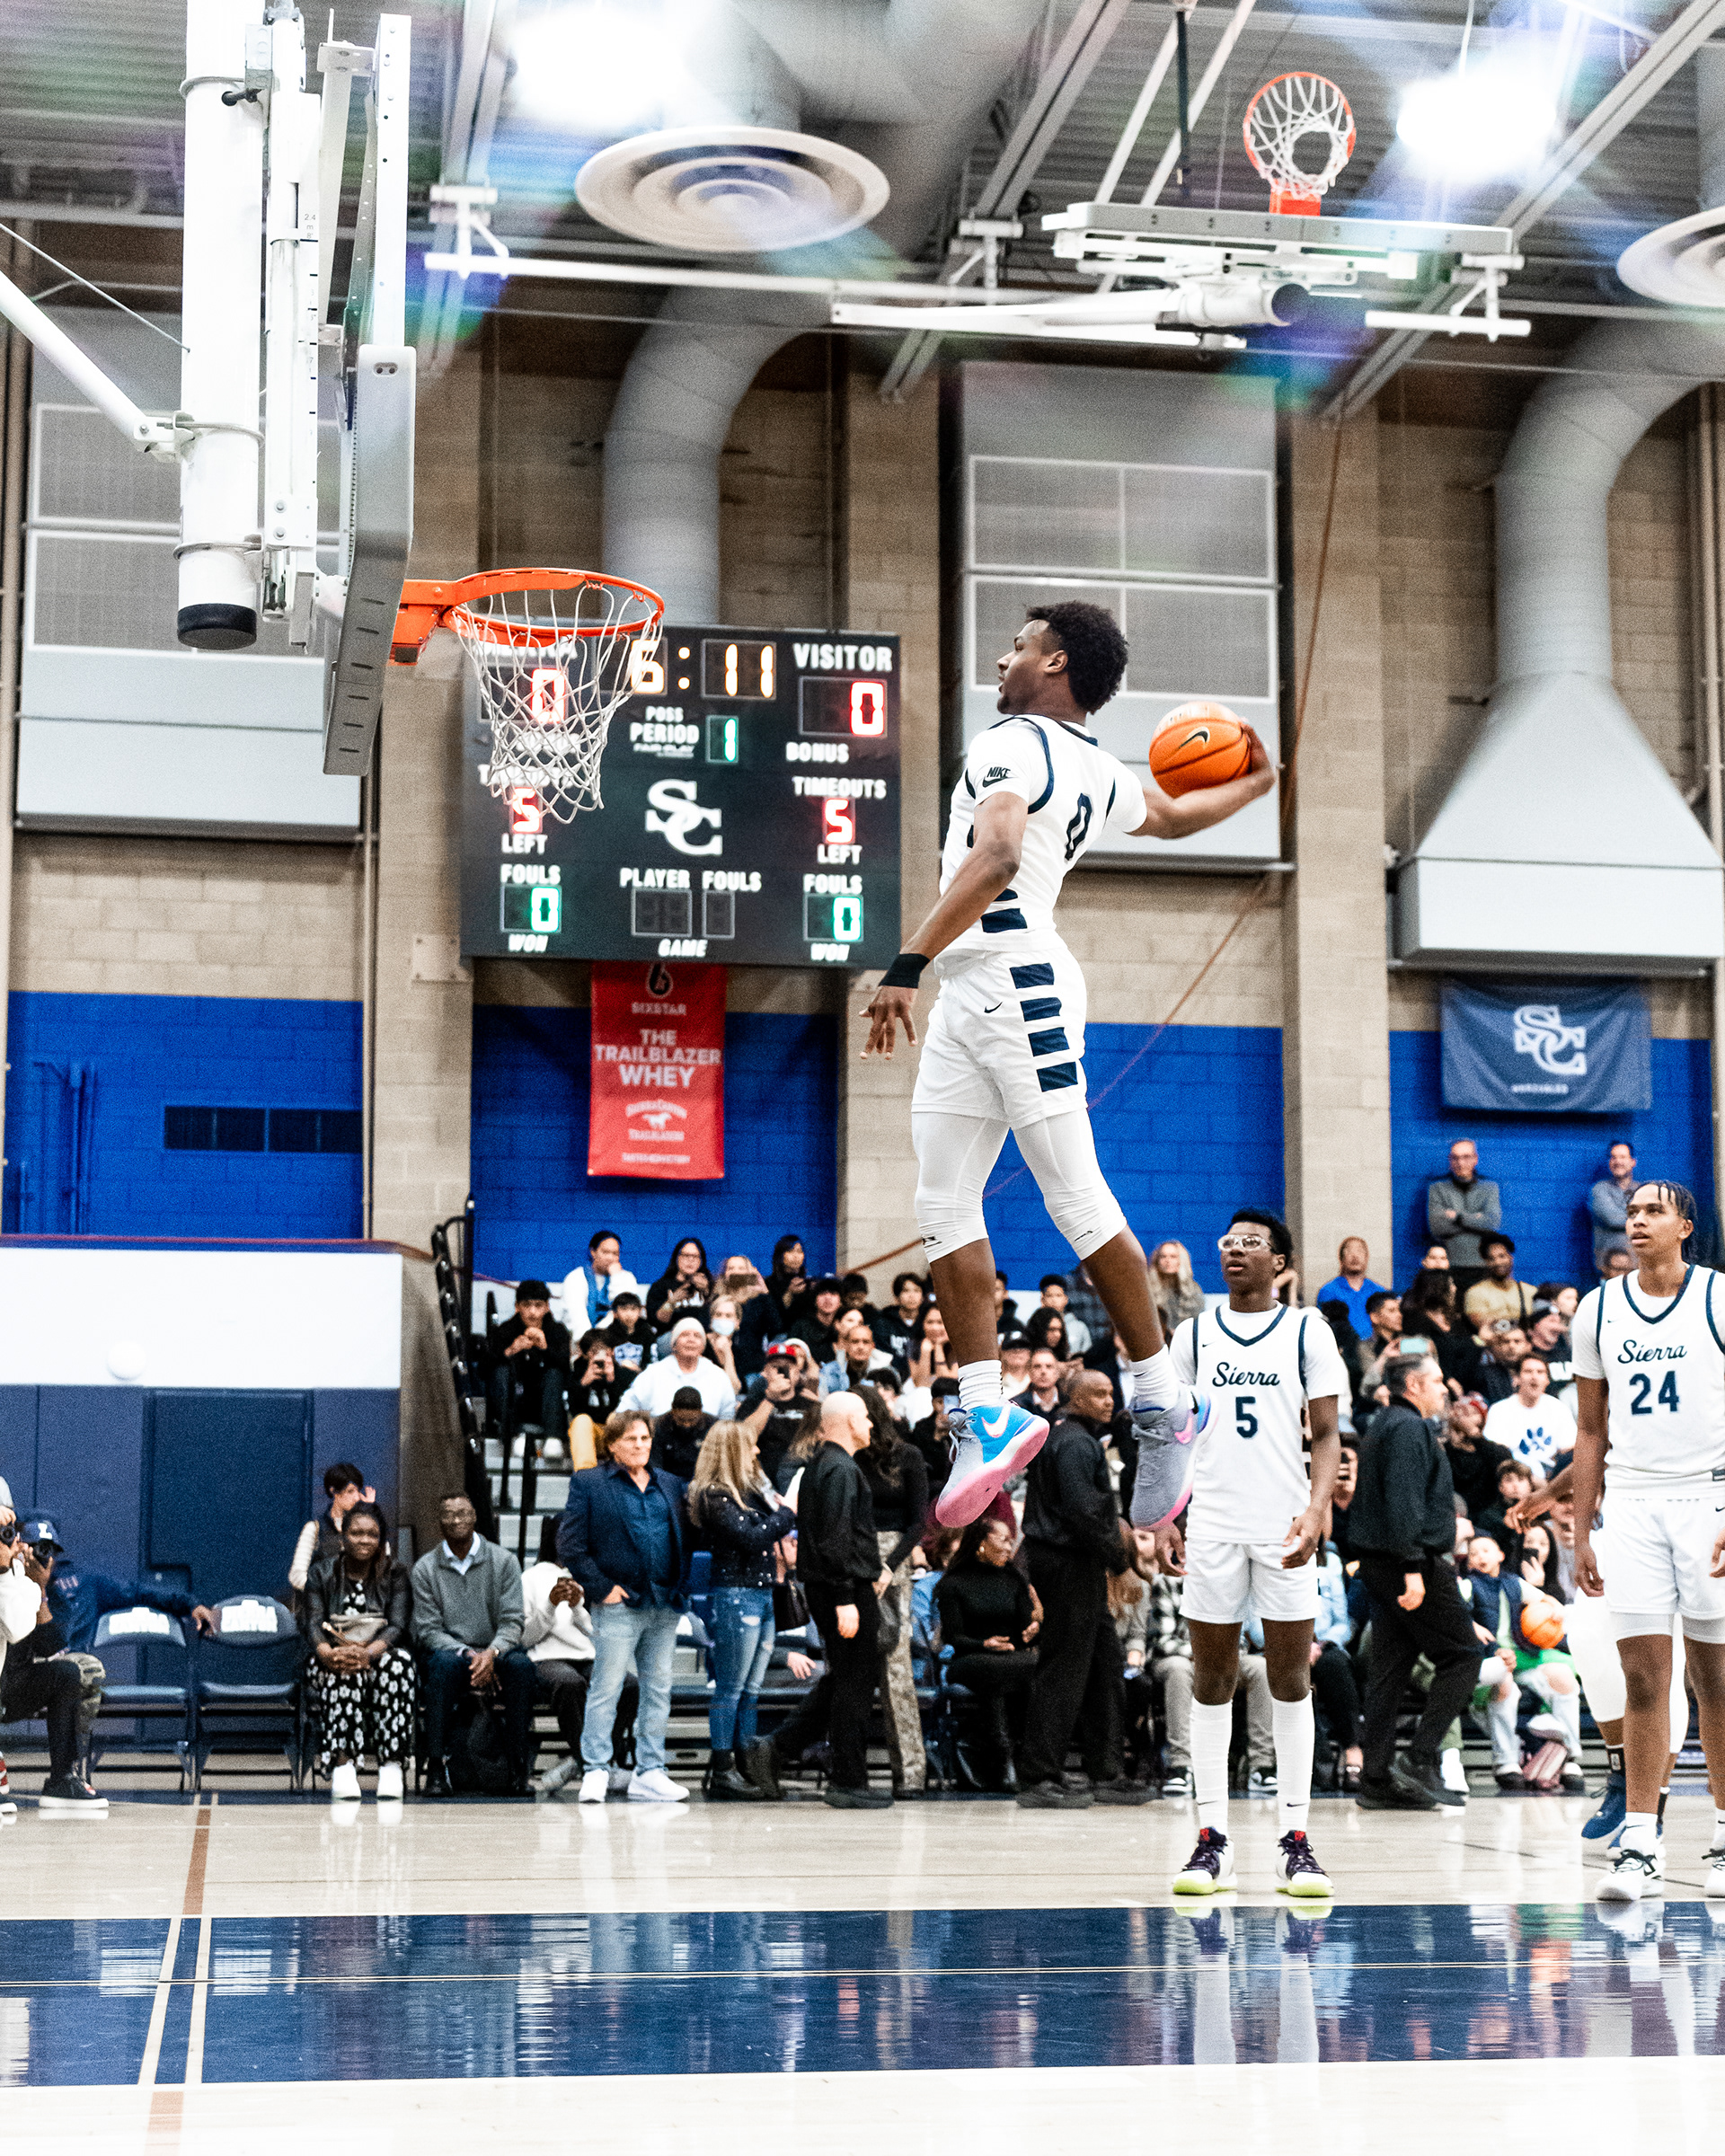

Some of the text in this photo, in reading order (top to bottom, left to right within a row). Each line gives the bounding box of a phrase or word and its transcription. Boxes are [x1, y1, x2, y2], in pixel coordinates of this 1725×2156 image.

[631, 639, 774, 699] 6:11
[792, 642, 893, 672] VISITOR
[531, 667, 565, 724] 0
[645, 705, 684, 722] POSS
[850, 681, 885, 737] 0
[630, 722, 699, 744] PERIOD
[724, 718, 737, 762] 1
[786, 741, 850, 764] BONUS
[986, 766, 1011, 779] NIKE
[792, 776, 888, 800] TIMEOUTS
[512, 787, 540, 834] 5
[644, 779, 722, 855] SC
[825, 798, 854, 844] 5
[1065, 792, 1093, 862] 0
[501, 834, 547, 854] LEFT
[817, 844, 862, 865] LEFT
[500, 864, 561, 885] FOULS
[620, 868, 762, 891] PLAYER FOULS
[803, 873, 862, 895] FOULS
[531, 887, 559, 932] 0
[833, 897, 861, 941] 0
[508, 934, 548, 952] WON
[658, 939, 708, 958] GAME
[810, 943, 850, 961] WON
[640, 1029, 677, 1047] THE
[1513, 1004, 1587, 1075] SC
[595, 1045, 721, 1065] TRAILBLAZER
[619, 1064, 695, 1088] WHEY
[1617, 1339, 1688, 1364] Sierra
[1212, 1362, 1280, 1387] Sierra
[1629, 1370, 1680, 1415] 24
[1235, 1396, 1258, 1438] 5
